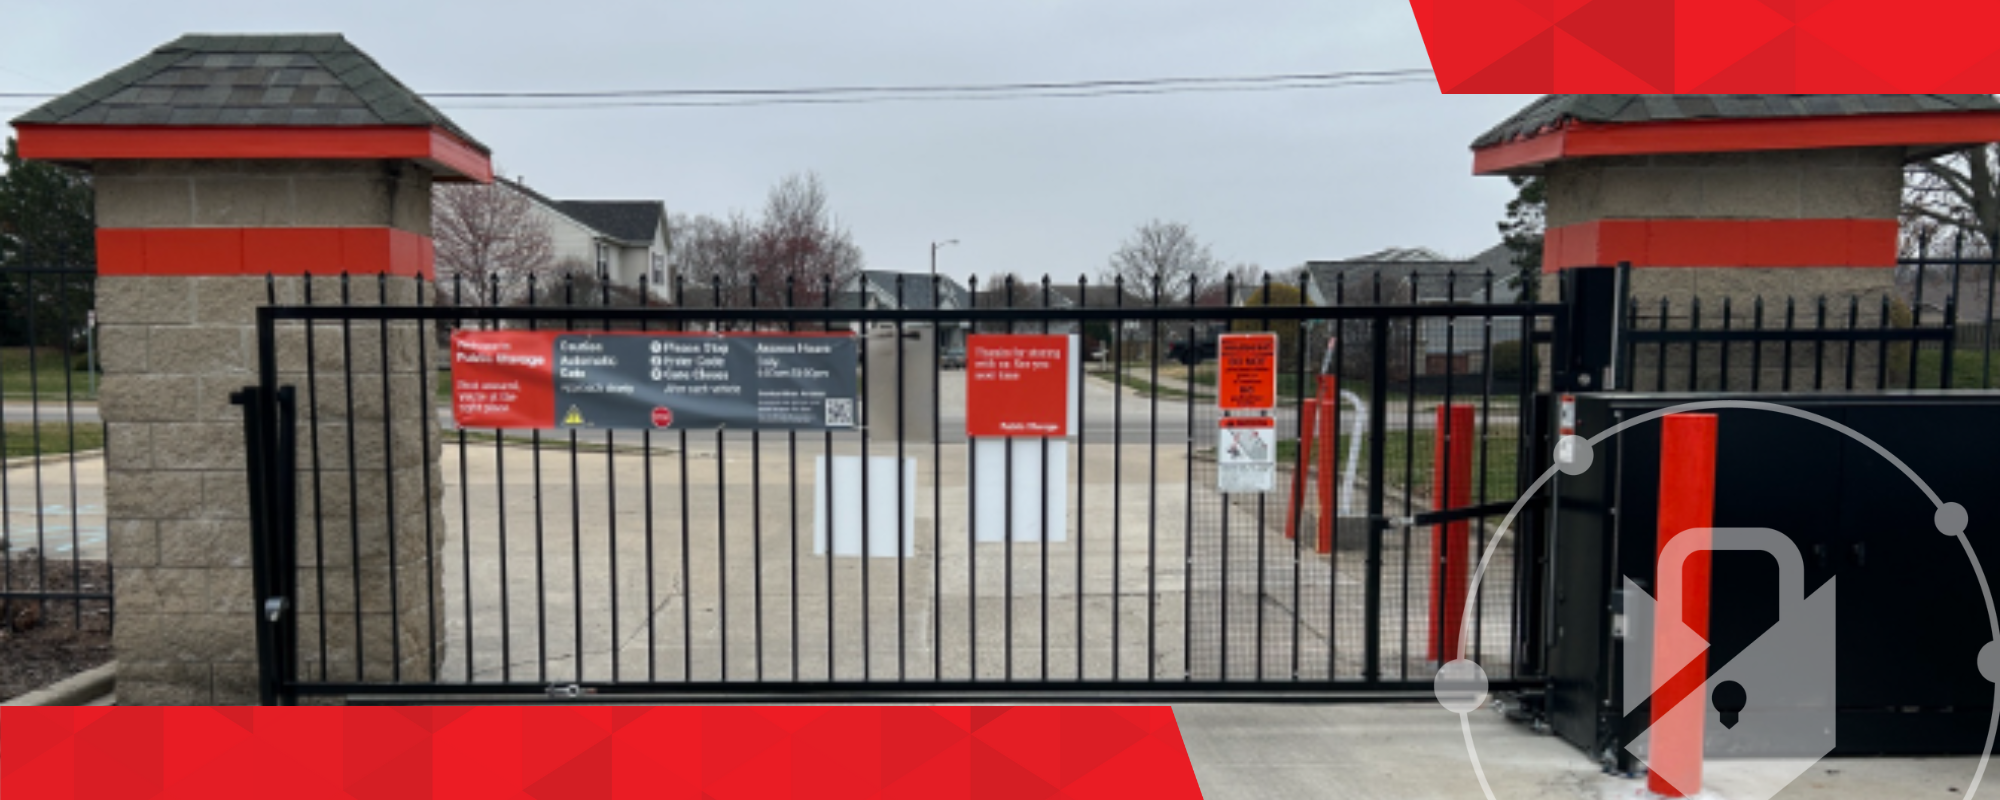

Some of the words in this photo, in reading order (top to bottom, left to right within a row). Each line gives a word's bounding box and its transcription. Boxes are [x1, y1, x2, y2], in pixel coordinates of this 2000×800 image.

[560, 340, 603, 352] Caution
[664, 342, 700, 353] Please
[457, 352, 493, 363] Public
[496, 353, 545, 368] Storage
[560, 355, 618, 367] Automatic
[560, 368, 586, 378] Gate
